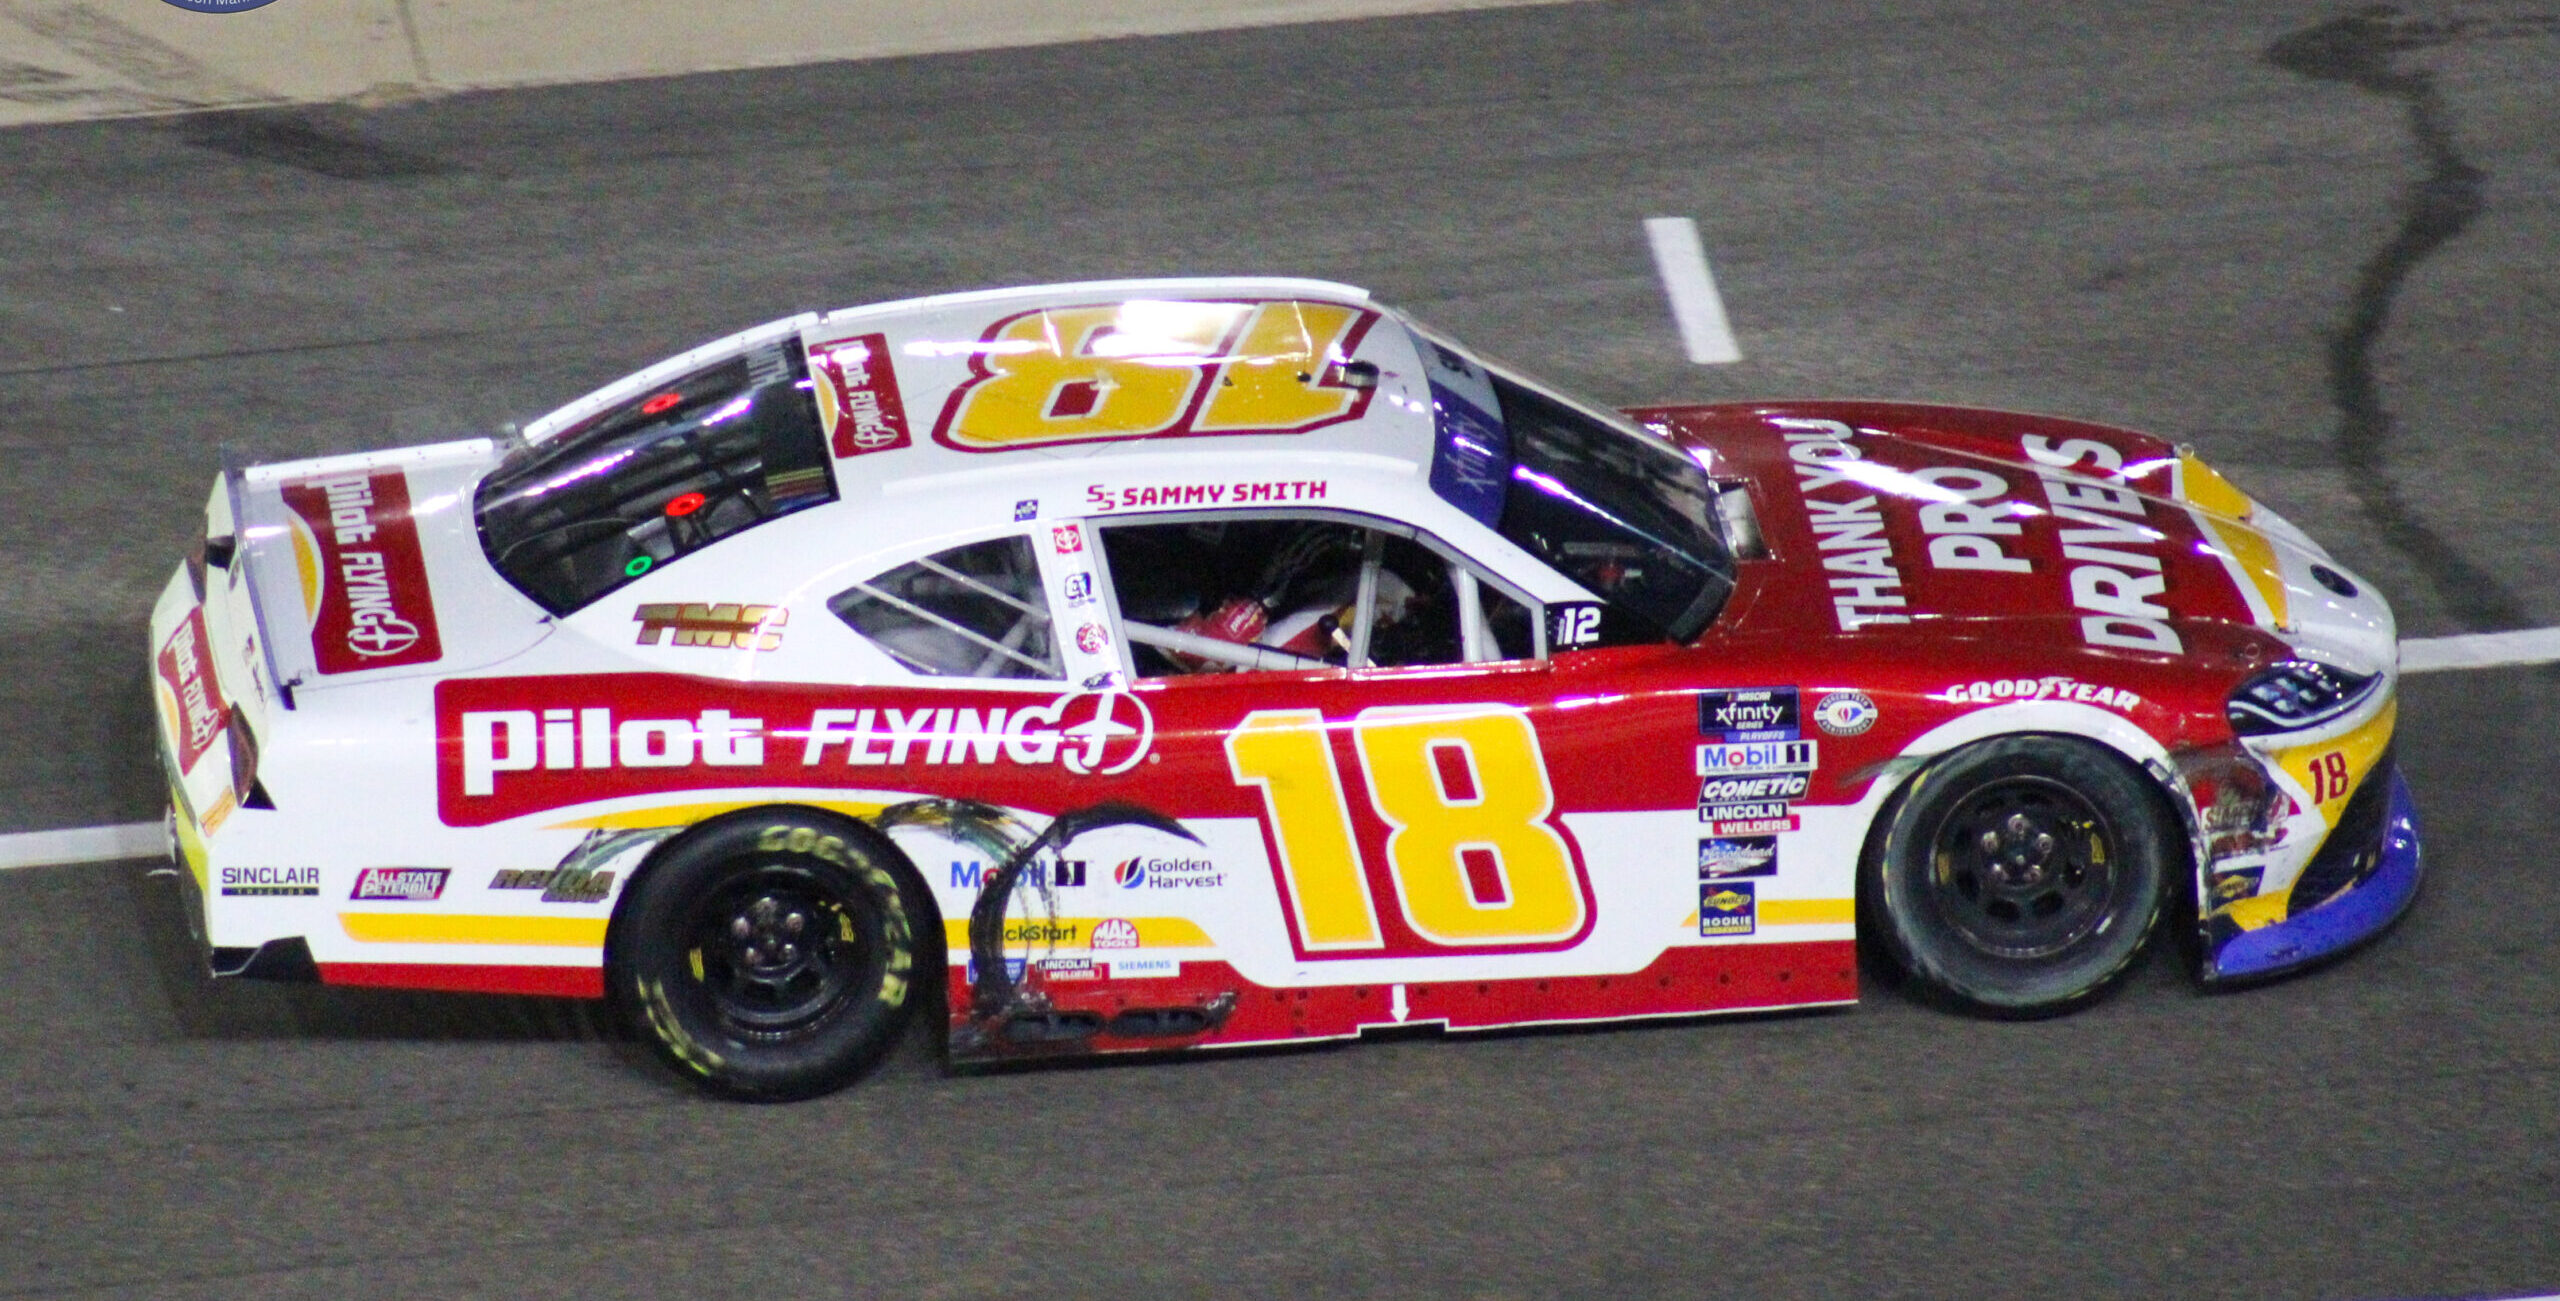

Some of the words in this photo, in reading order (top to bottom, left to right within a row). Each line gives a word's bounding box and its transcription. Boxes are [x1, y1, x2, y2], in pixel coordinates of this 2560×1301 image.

[934, 300, 1381, 454] 18
[1784, 419, 1861, 492] YOU
[1122, 486, 1225, 506] SAMMY
[1232, 481, 1327, 502] SMITH
[1910, 467, 2032, 573] PRO
[1804, 496, 1911, 631] THANK
[340, 551, 397, 636] FLYING
[632, 602, 789, 652] TMC
[1736, 691, 1772, 702] NASCAR
[1716, 703, 1783, 726] xfinity
[803, 706, 1062, 766] FLYING
[1740, 730, 1786, 741] PLAYOFFS
[1704, 745, 1777, 768] Mobil
[1703, 772, 1807, 800] COMETIC
[2309, 751, 2350, 804] 18
[1702, 803, 1783, 821] LINCOLN
[1224, 703, 1598, 961] 18
[1720, 819, 1792, 835] WELDERS
[222, 867, 319, 883] SINCLAIR
[365, 868, 442, 884] ALLSTATE
[1149, 858, 1213, 872] Golden
[1149, 873, 1224, 888] Harvest
[1092, 920, 1136, 940] MAC
[1703, 915, 1753, 927] ROOKIE
[1117, 960, 1172, 970] SIEMENS
